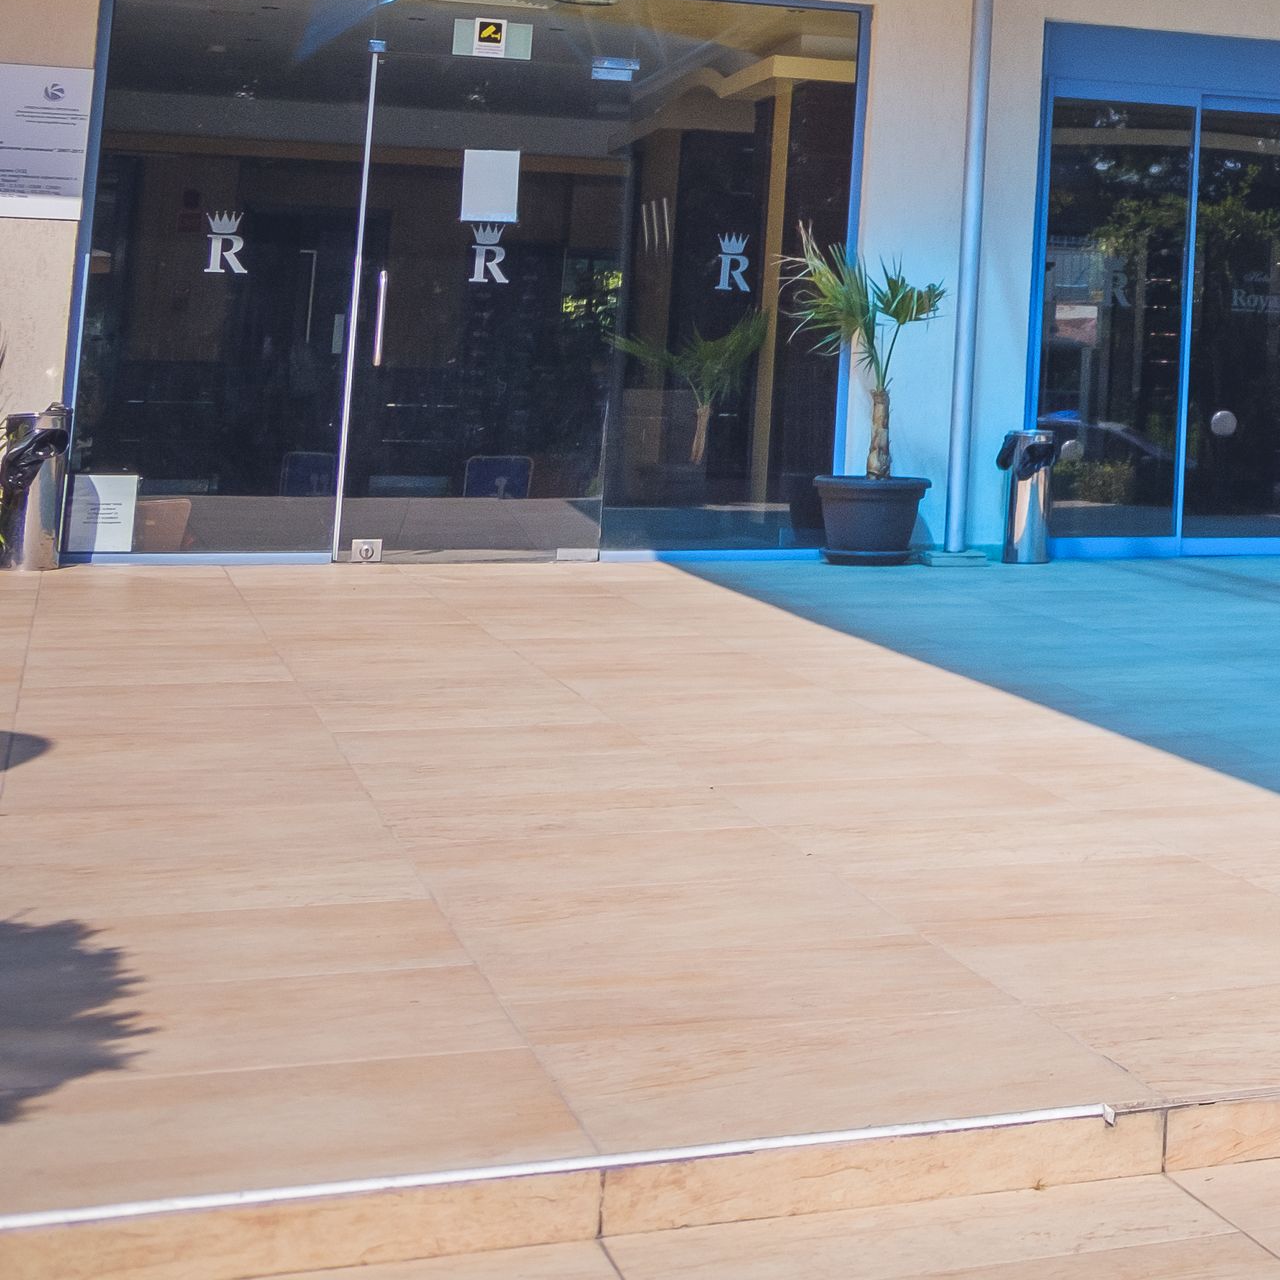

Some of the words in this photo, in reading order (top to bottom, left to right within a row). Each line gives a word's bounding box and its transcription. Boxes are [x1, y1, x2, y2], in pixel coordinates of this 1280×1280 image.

[204, 234, 248, 274] R
[468, 245, 509, 284] R
[715, 255, 751, 293] R
[1104, 270, 1132, 308] R
